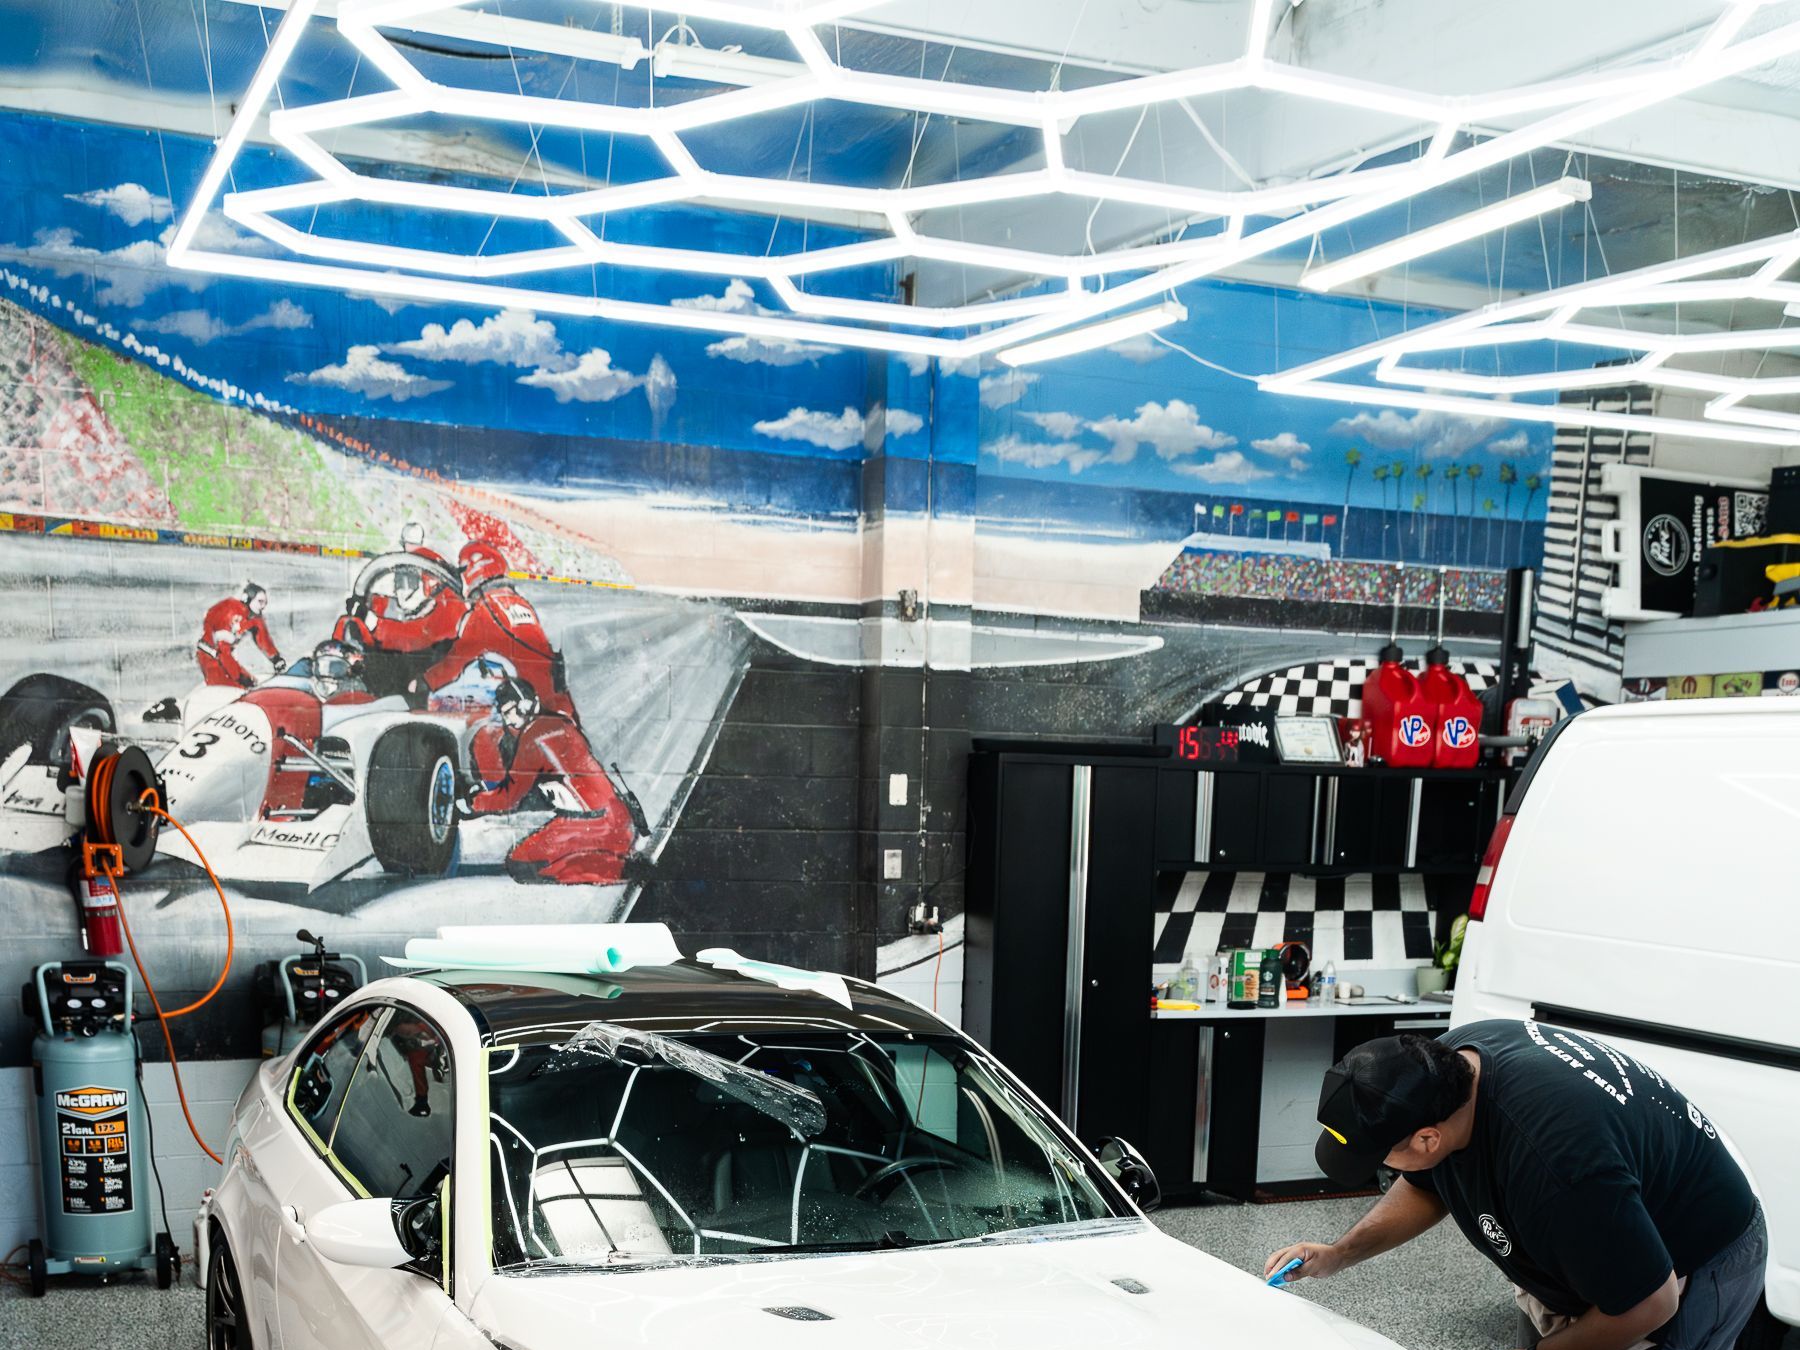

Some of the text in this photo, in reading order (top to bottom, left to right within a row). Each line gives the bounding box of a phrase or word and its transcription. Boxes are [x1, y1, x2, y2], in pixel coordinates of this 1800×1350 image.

[1692, 495, 1704, 562] Detailing
[1403, 717, 1422, 744] VP
[1447, 718, 1467, 746] VP
[179, 732, 220, 759] 3
[1543, 1045, 1585, 1068] AUTO
[57, 1092, 126, 1108] McGRAW
[1583, 1069, 1628, 1105] PURE
